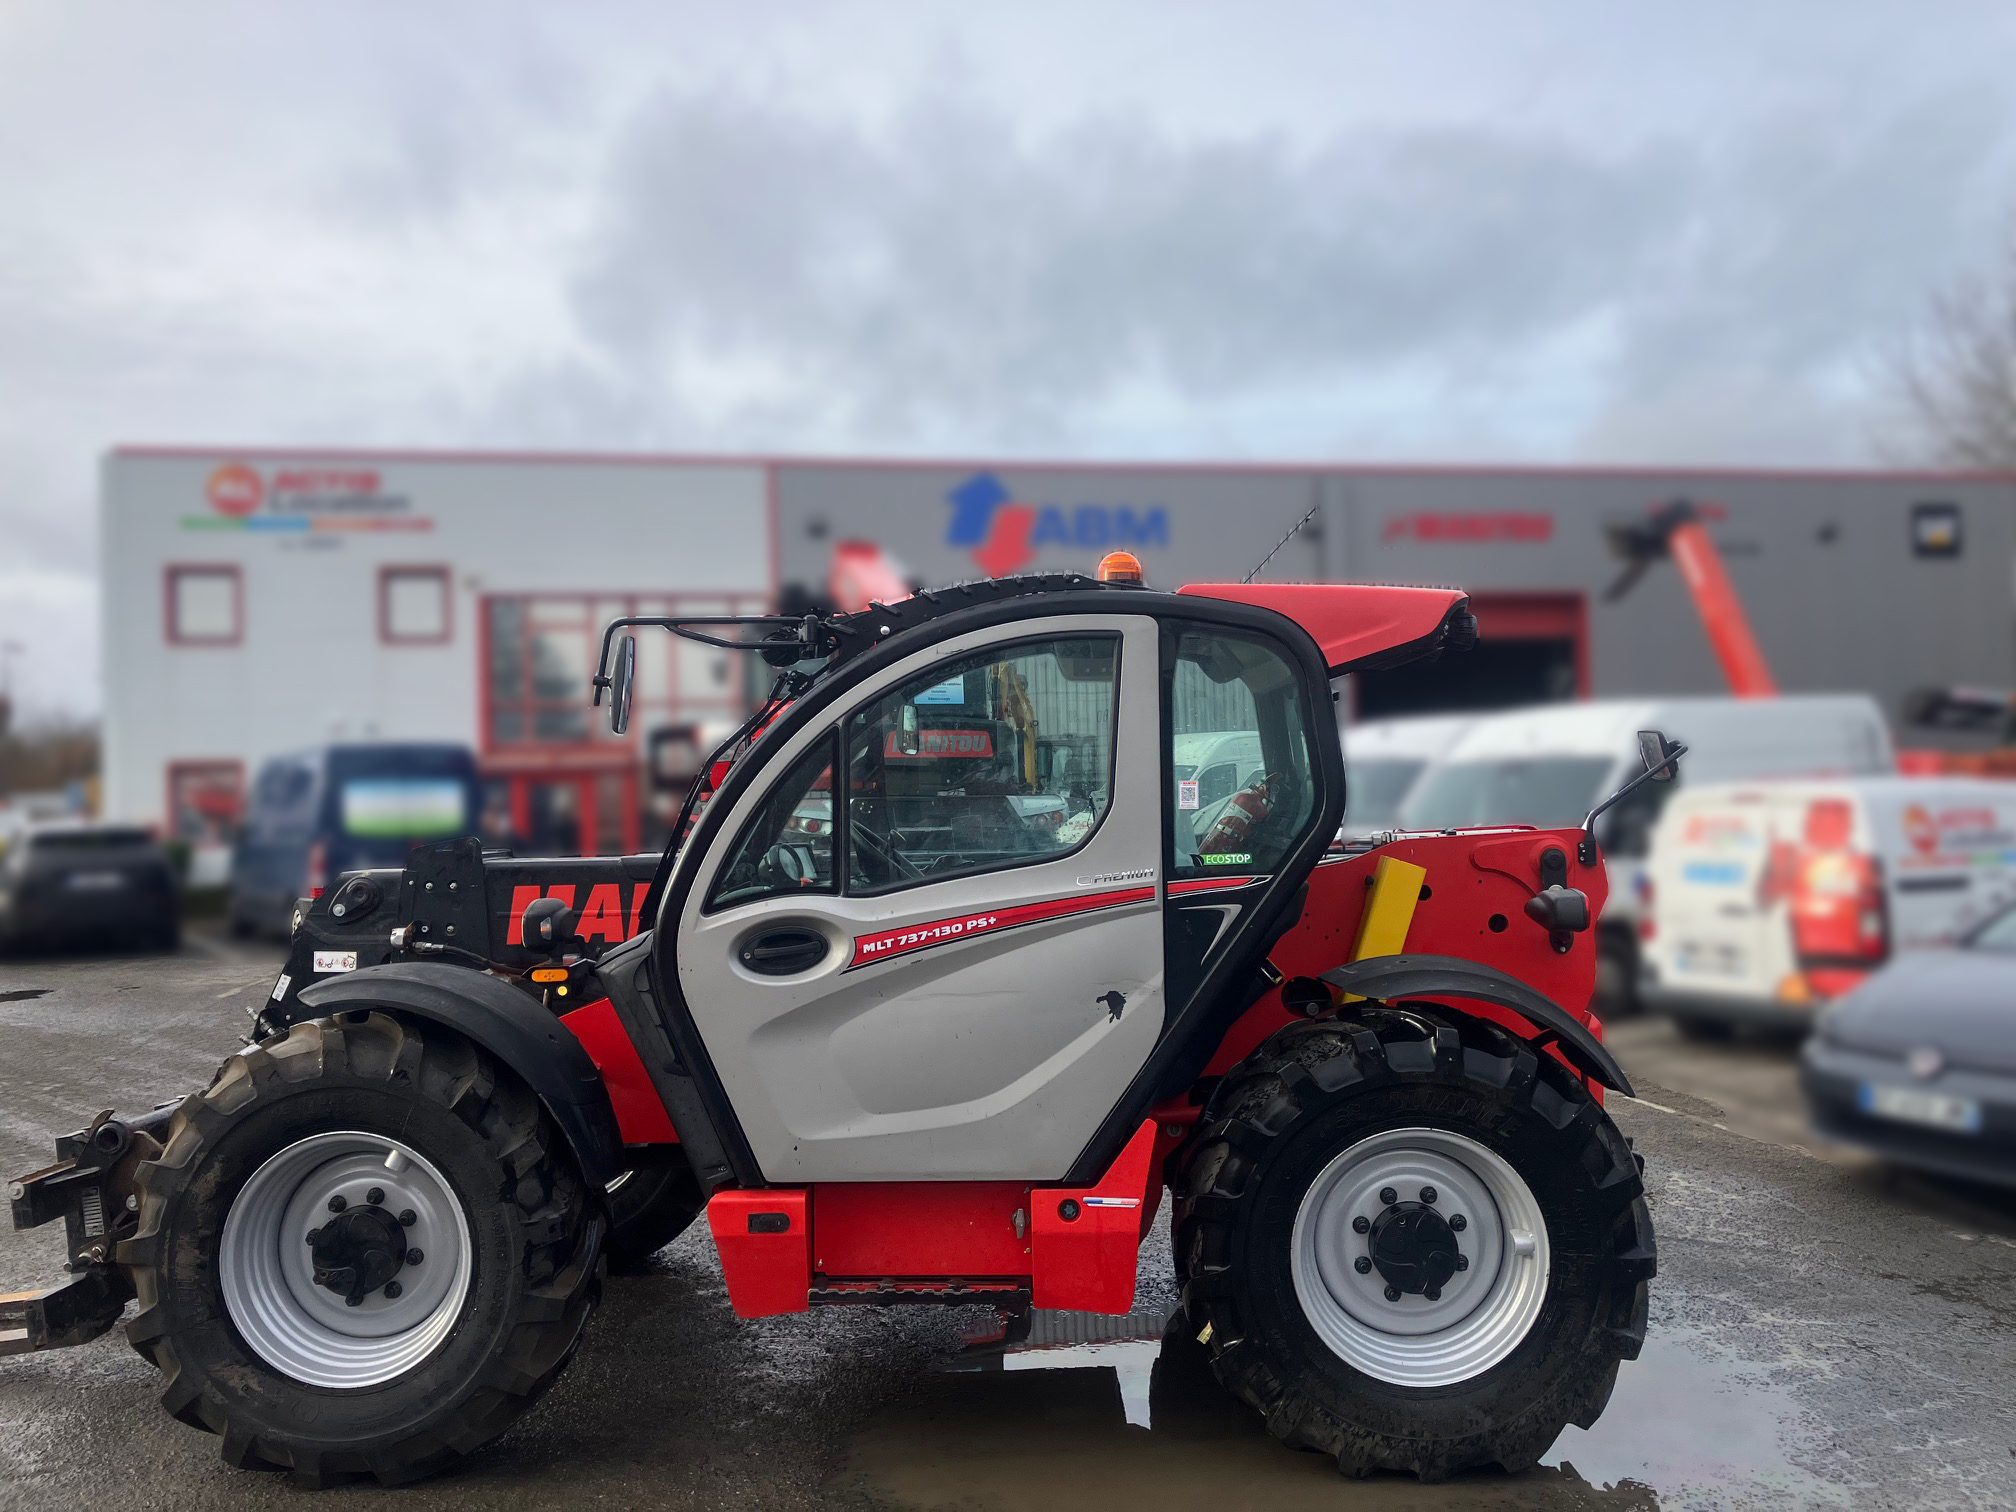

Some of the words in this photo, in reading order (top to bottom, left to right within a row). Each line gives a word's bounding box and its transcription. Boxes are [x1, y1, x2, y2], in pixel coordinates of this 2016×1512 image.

[1031, 506, 1168, 546] ABM
[1206, 854, 1250, 864] ECOSTOP
[1094, 868, 1154, 884] PREMIUM
[863, 937, 894, 953] MLT
[898, 923, 962, 945] 737-130
[966, 916, 997, 931] PS+
